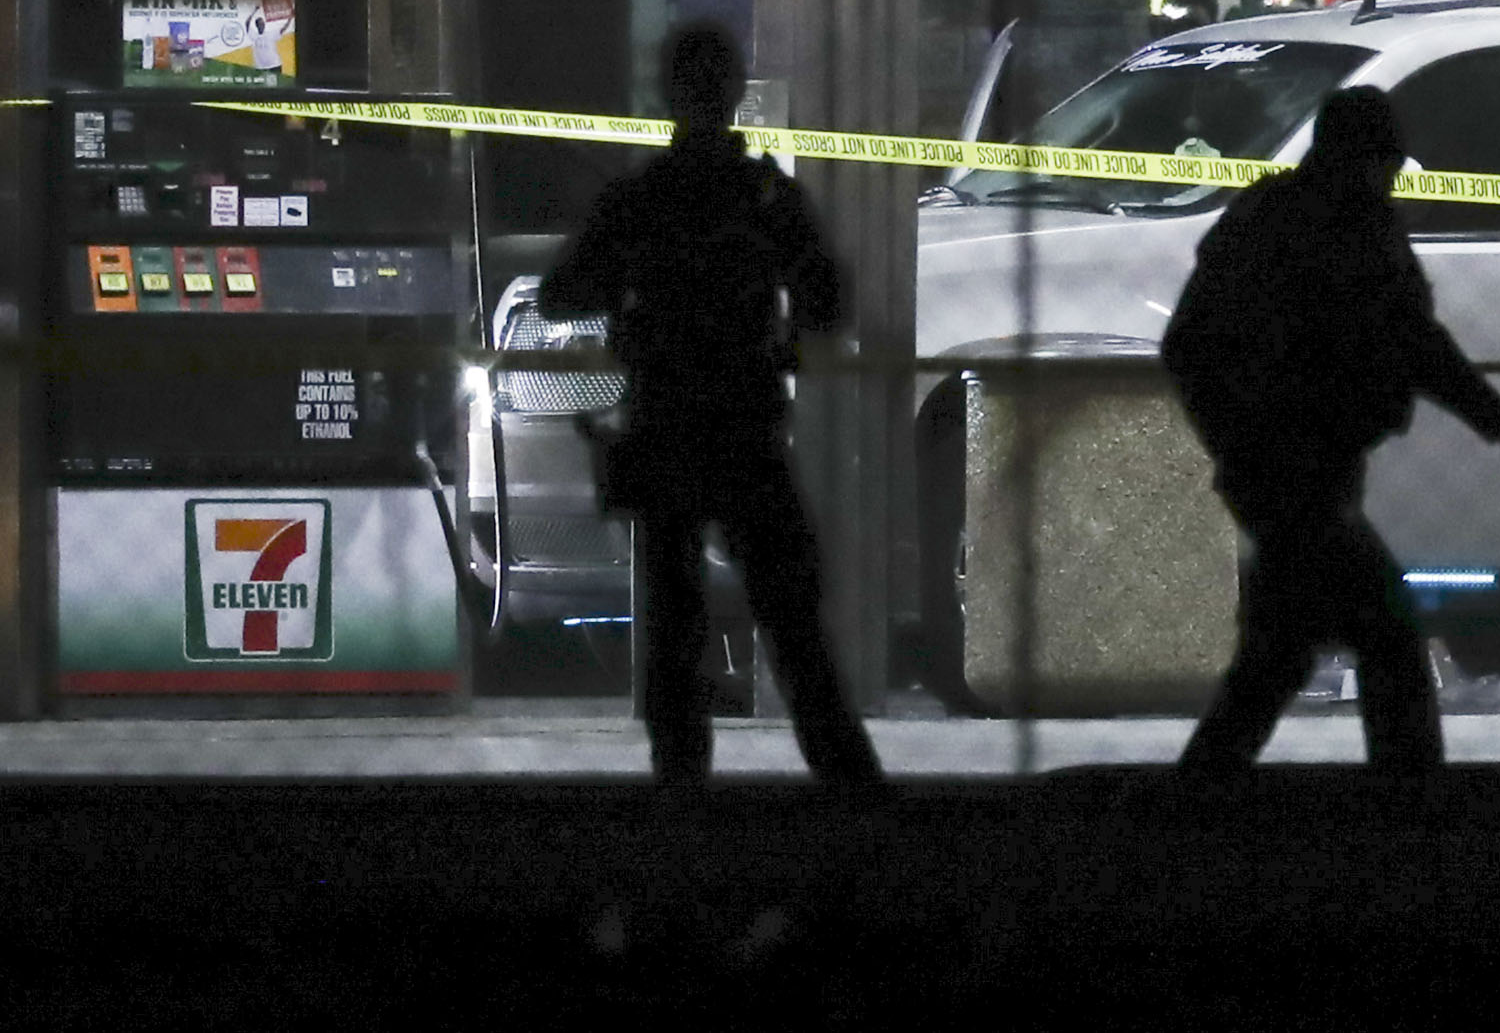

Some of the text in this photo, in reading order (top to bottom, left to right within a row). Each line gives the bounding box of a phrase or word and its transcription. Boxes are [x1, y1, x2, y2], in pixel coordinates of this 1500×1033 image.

[368, 103, 410, 120] POLICE
[424, 107, 467, 123] CROSS
[793, 133, 964, 162] POLICE LINE DO NOT CROSS
[977, 146, 1146, 175] POLICE LINE DO NOT CROSS
[1160, 158, 1202, 178] CROSS
[1208, 161, 1232, 181] NOT
[1237, 163, 1254, 182] DO
[1419, 175, 1436, 193] DO
[1439, 176, 1465, 195] LINE
[299, 385, 355, 402] CONTAINS
[296, 404, 359, 420] UP TO 10%
[302, 422, 352, 439] ETHANOL
[215, 519, 307, 652] 7
